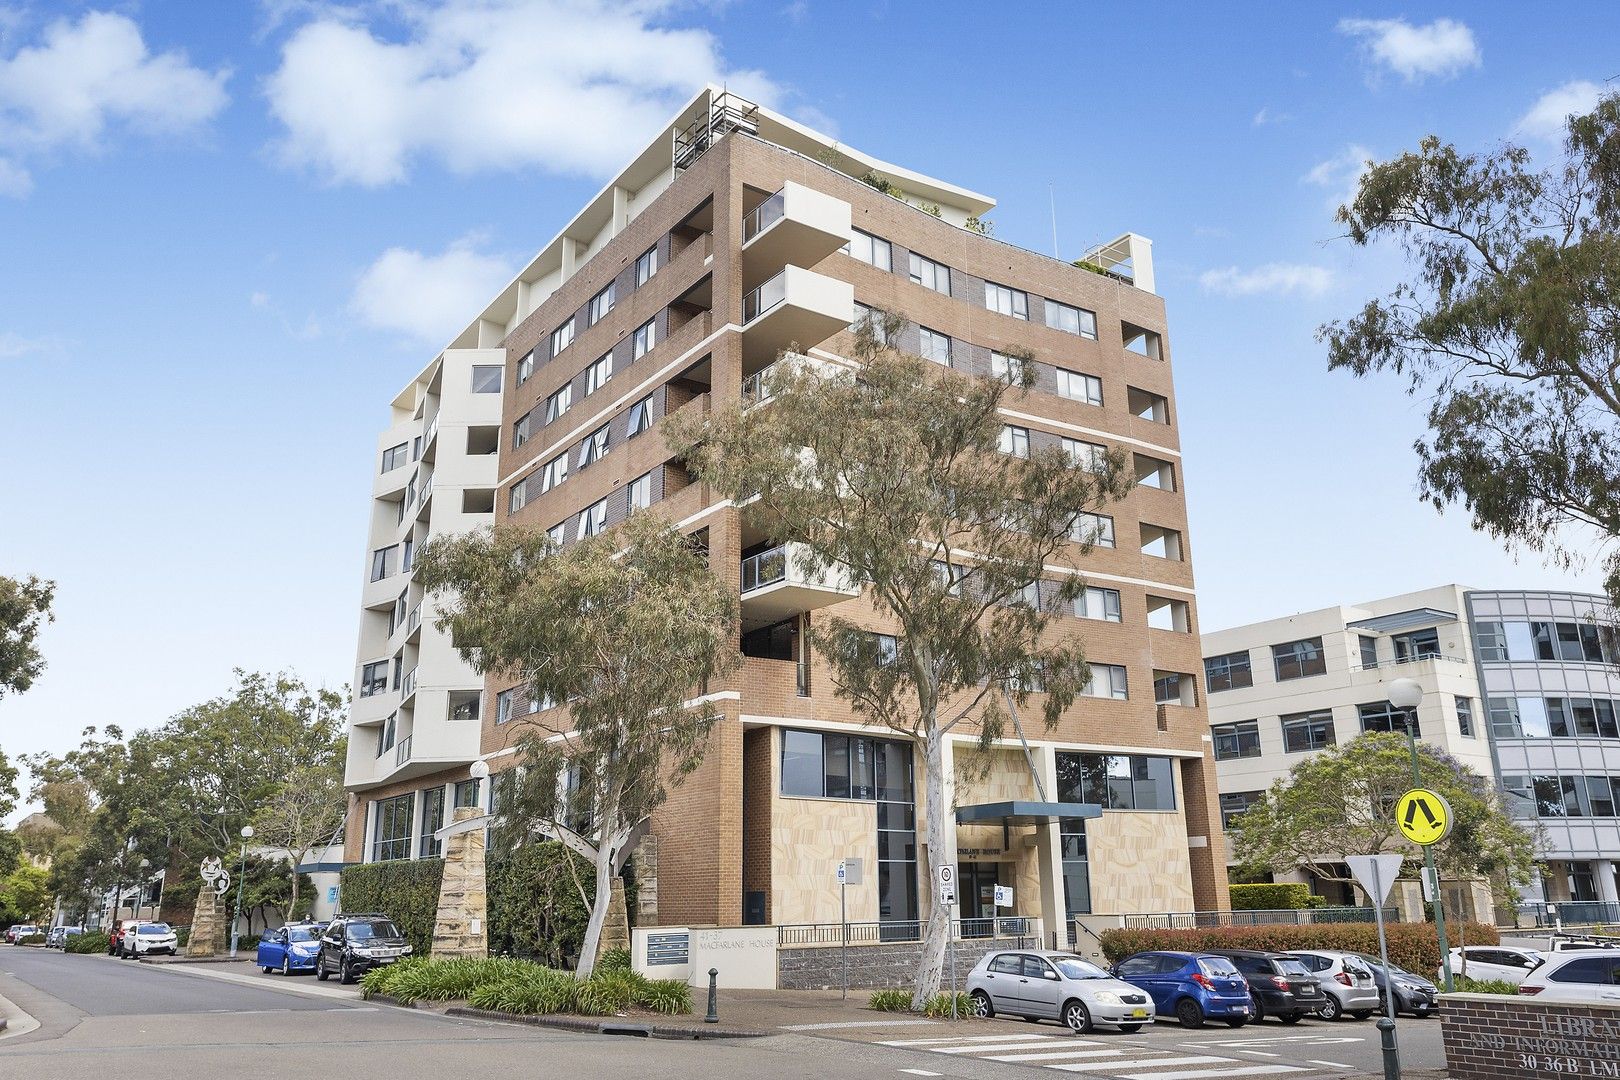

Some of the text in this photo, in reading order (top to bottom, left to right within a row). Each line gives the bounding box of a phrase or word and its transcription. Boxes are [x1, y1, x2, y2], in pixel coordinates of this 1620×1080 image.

[700, 939, 774, 950] MACFARLANE HOUSE
[1471, 1034, 1506, 1050] AND
